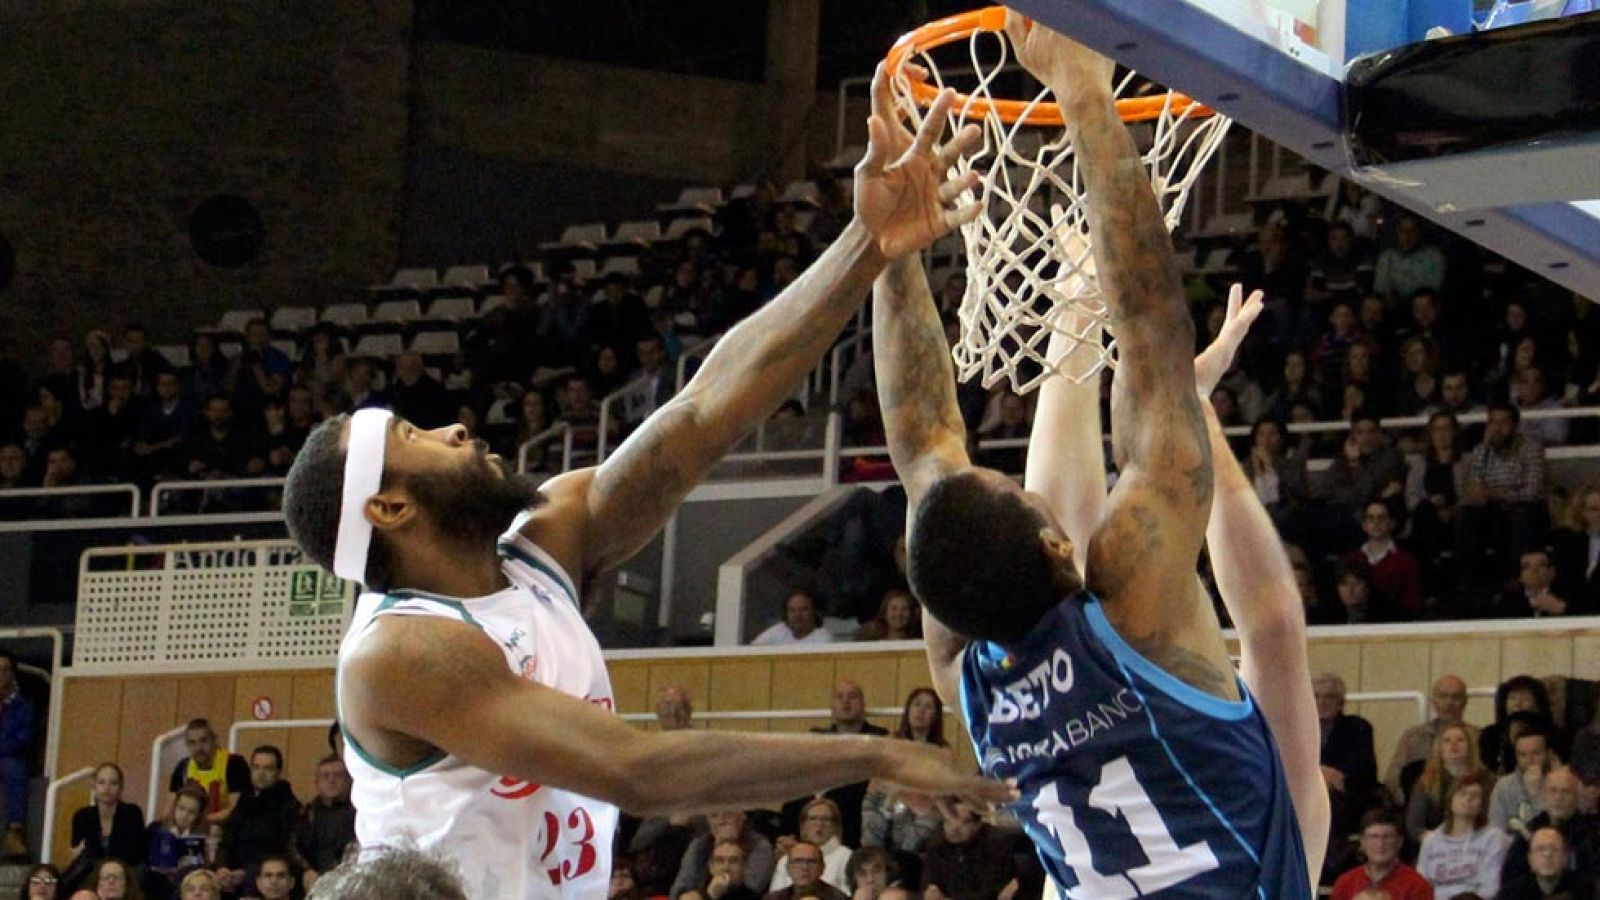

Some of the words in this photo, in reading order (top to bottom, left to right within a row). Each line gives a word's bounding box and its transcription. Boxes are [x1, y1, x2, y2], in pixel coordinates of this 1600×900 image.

[988, 647, 1075, 724] BETO
[538, 806, 597, 886] 23
[1032, 755, 1220, 900] 11
